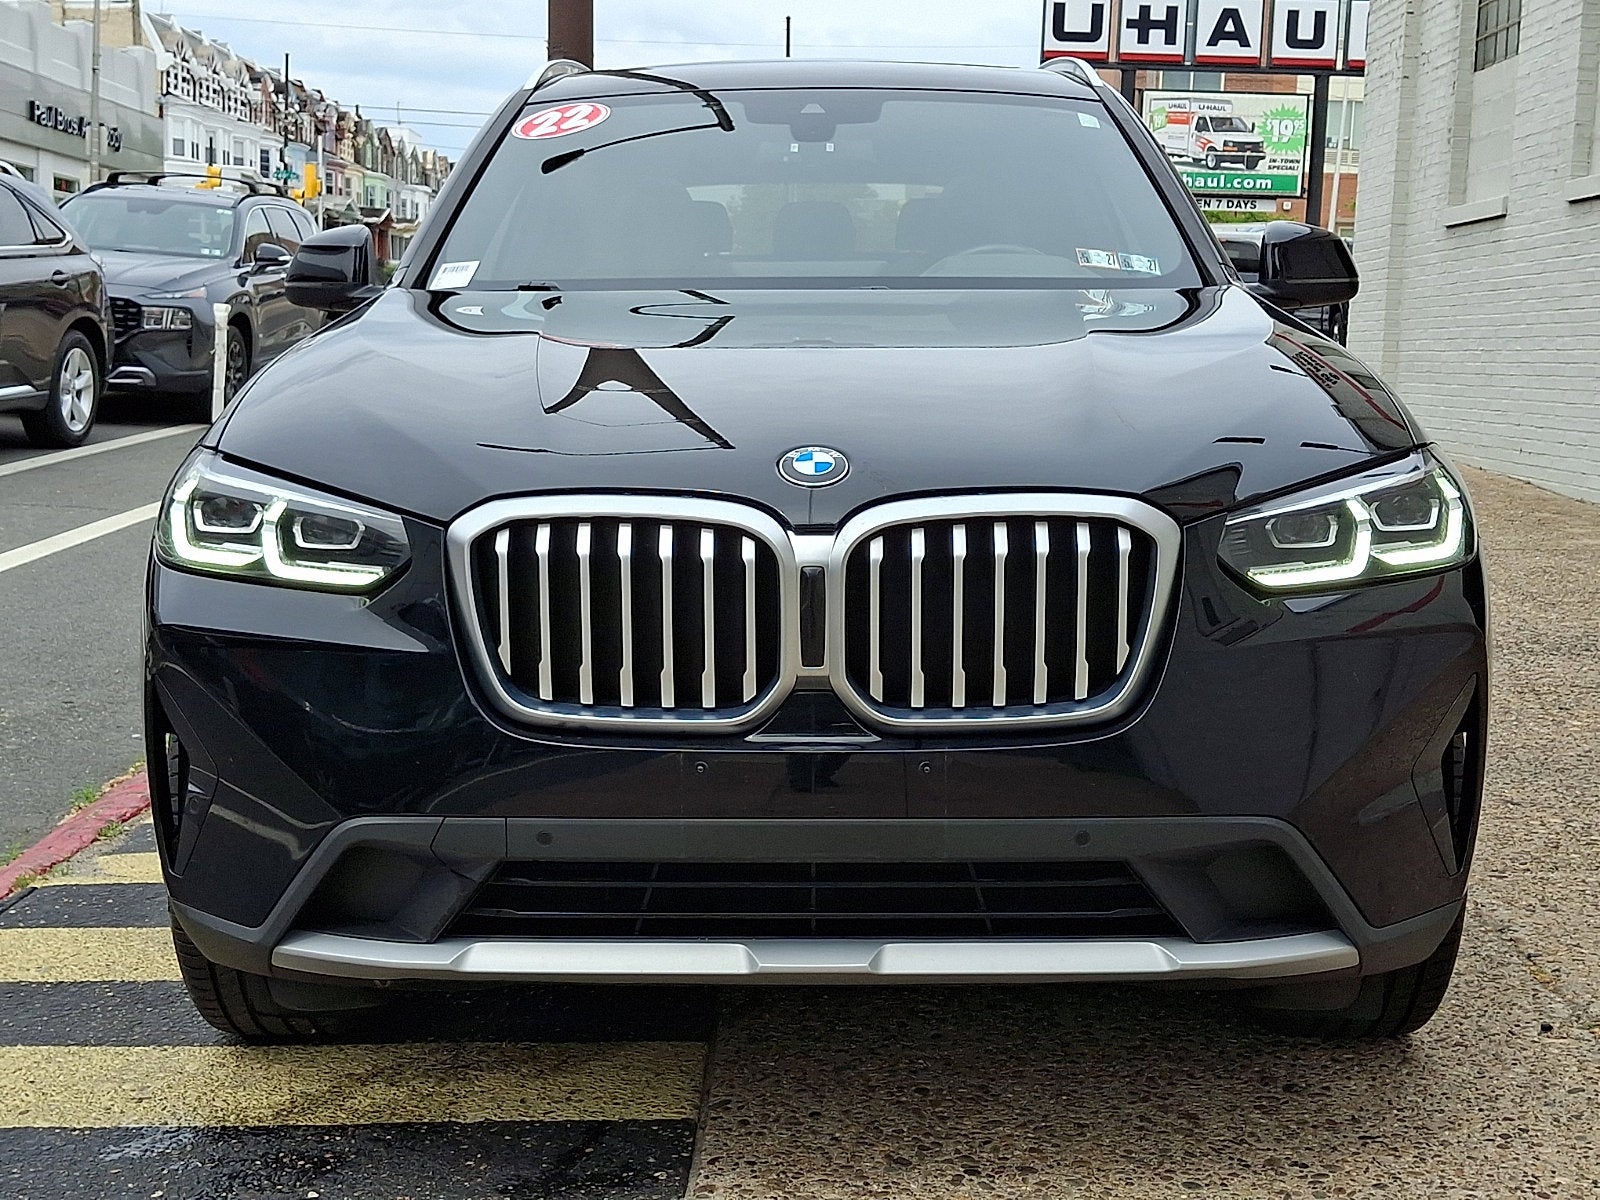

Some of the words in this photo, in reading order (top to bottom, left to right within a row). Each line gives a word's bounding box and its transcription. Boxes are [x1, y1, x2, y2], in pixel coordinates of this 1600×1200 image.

[29, 99, 55, 128] Paul
[529, 105, 595, 137] 22
[1215, 199, 1223, 209] 7
[1226, 199, 1257, 210] DAYS
